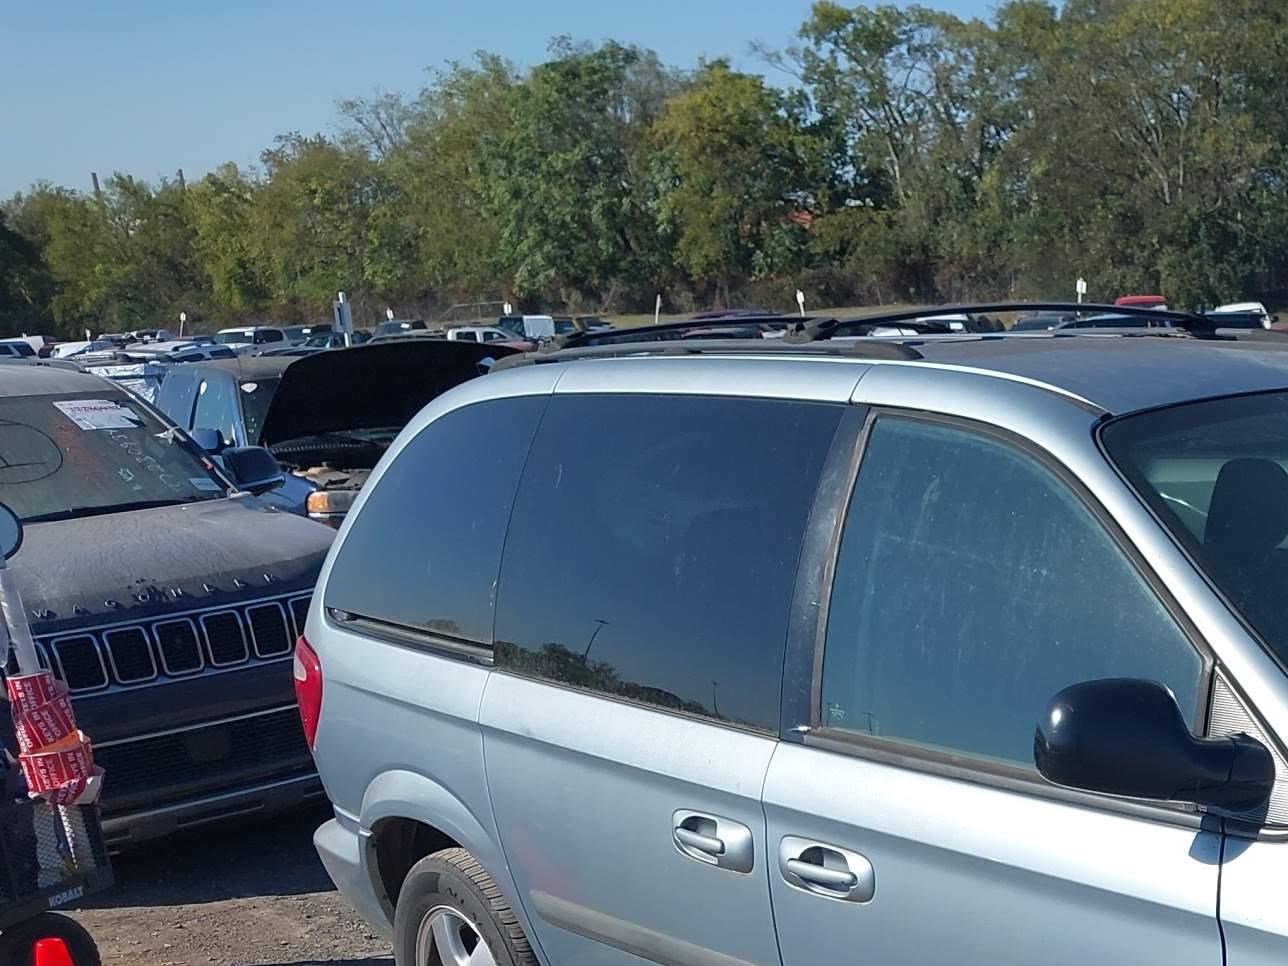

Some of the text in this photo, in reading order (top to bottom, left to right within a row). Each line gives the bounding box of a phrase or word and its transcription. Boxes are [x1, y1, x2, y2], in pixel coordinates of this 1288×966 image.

[39, 722, 55, 743] KEYS
[41, 710, 61, 737] OFFICE
[40, 769, 51, 790] KEYS
[46, 758, 60, 787] OFFICE
[48, 886, 84, 908] KOBALT
